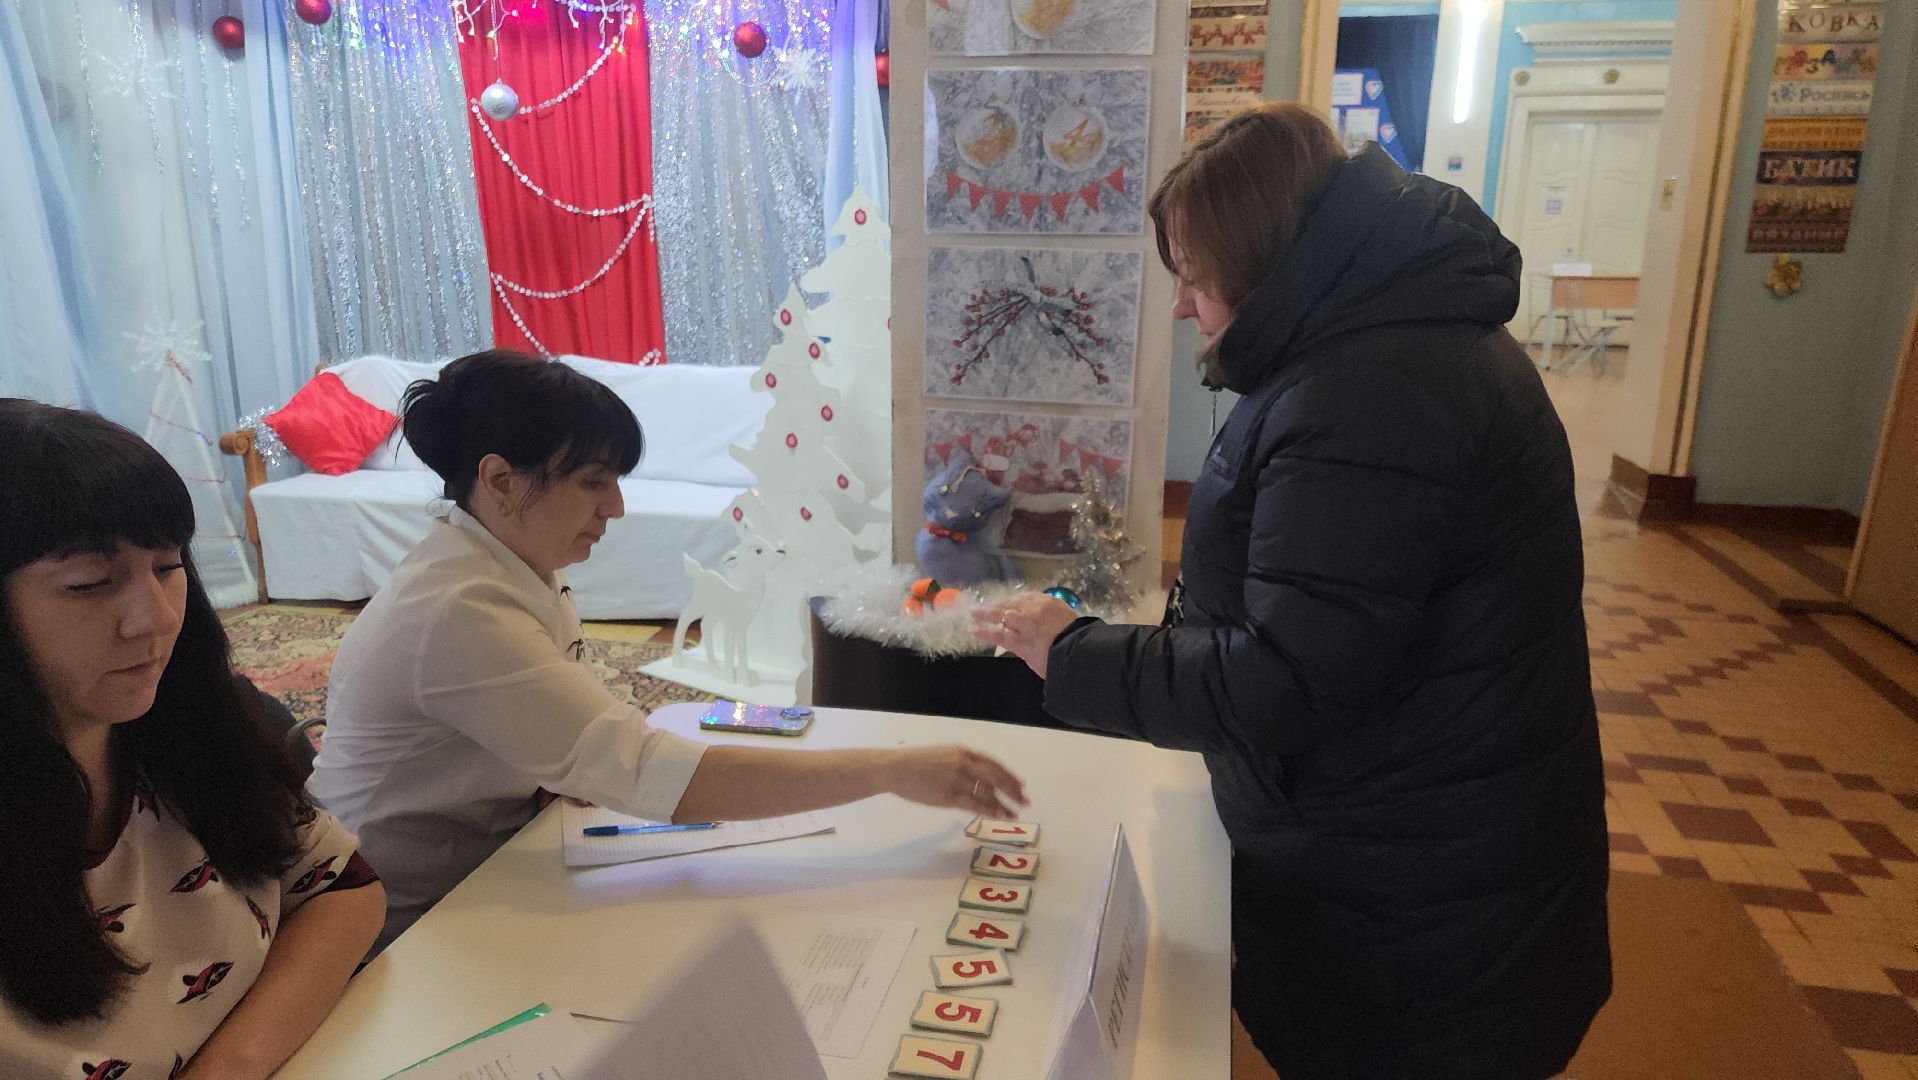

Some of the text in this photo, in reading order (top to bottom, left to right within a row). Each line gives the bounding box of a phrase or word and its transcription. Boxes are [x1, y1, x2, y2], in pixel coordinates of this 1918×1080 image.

[1789, 11, 1879, 33] КОВКА
[1764, 157, 1857, 180] БАТИК
[992, 826, 1027, 835] 1
[989, 854, 1027, 870] 2
[979, 887, 1018, 902] 3
[969, 922, 1009, 939] 4
[952, 960, 997, 978] 5
[935, 1001, 983, 1023] 5
[916, 1050, 965, 1071] 7
